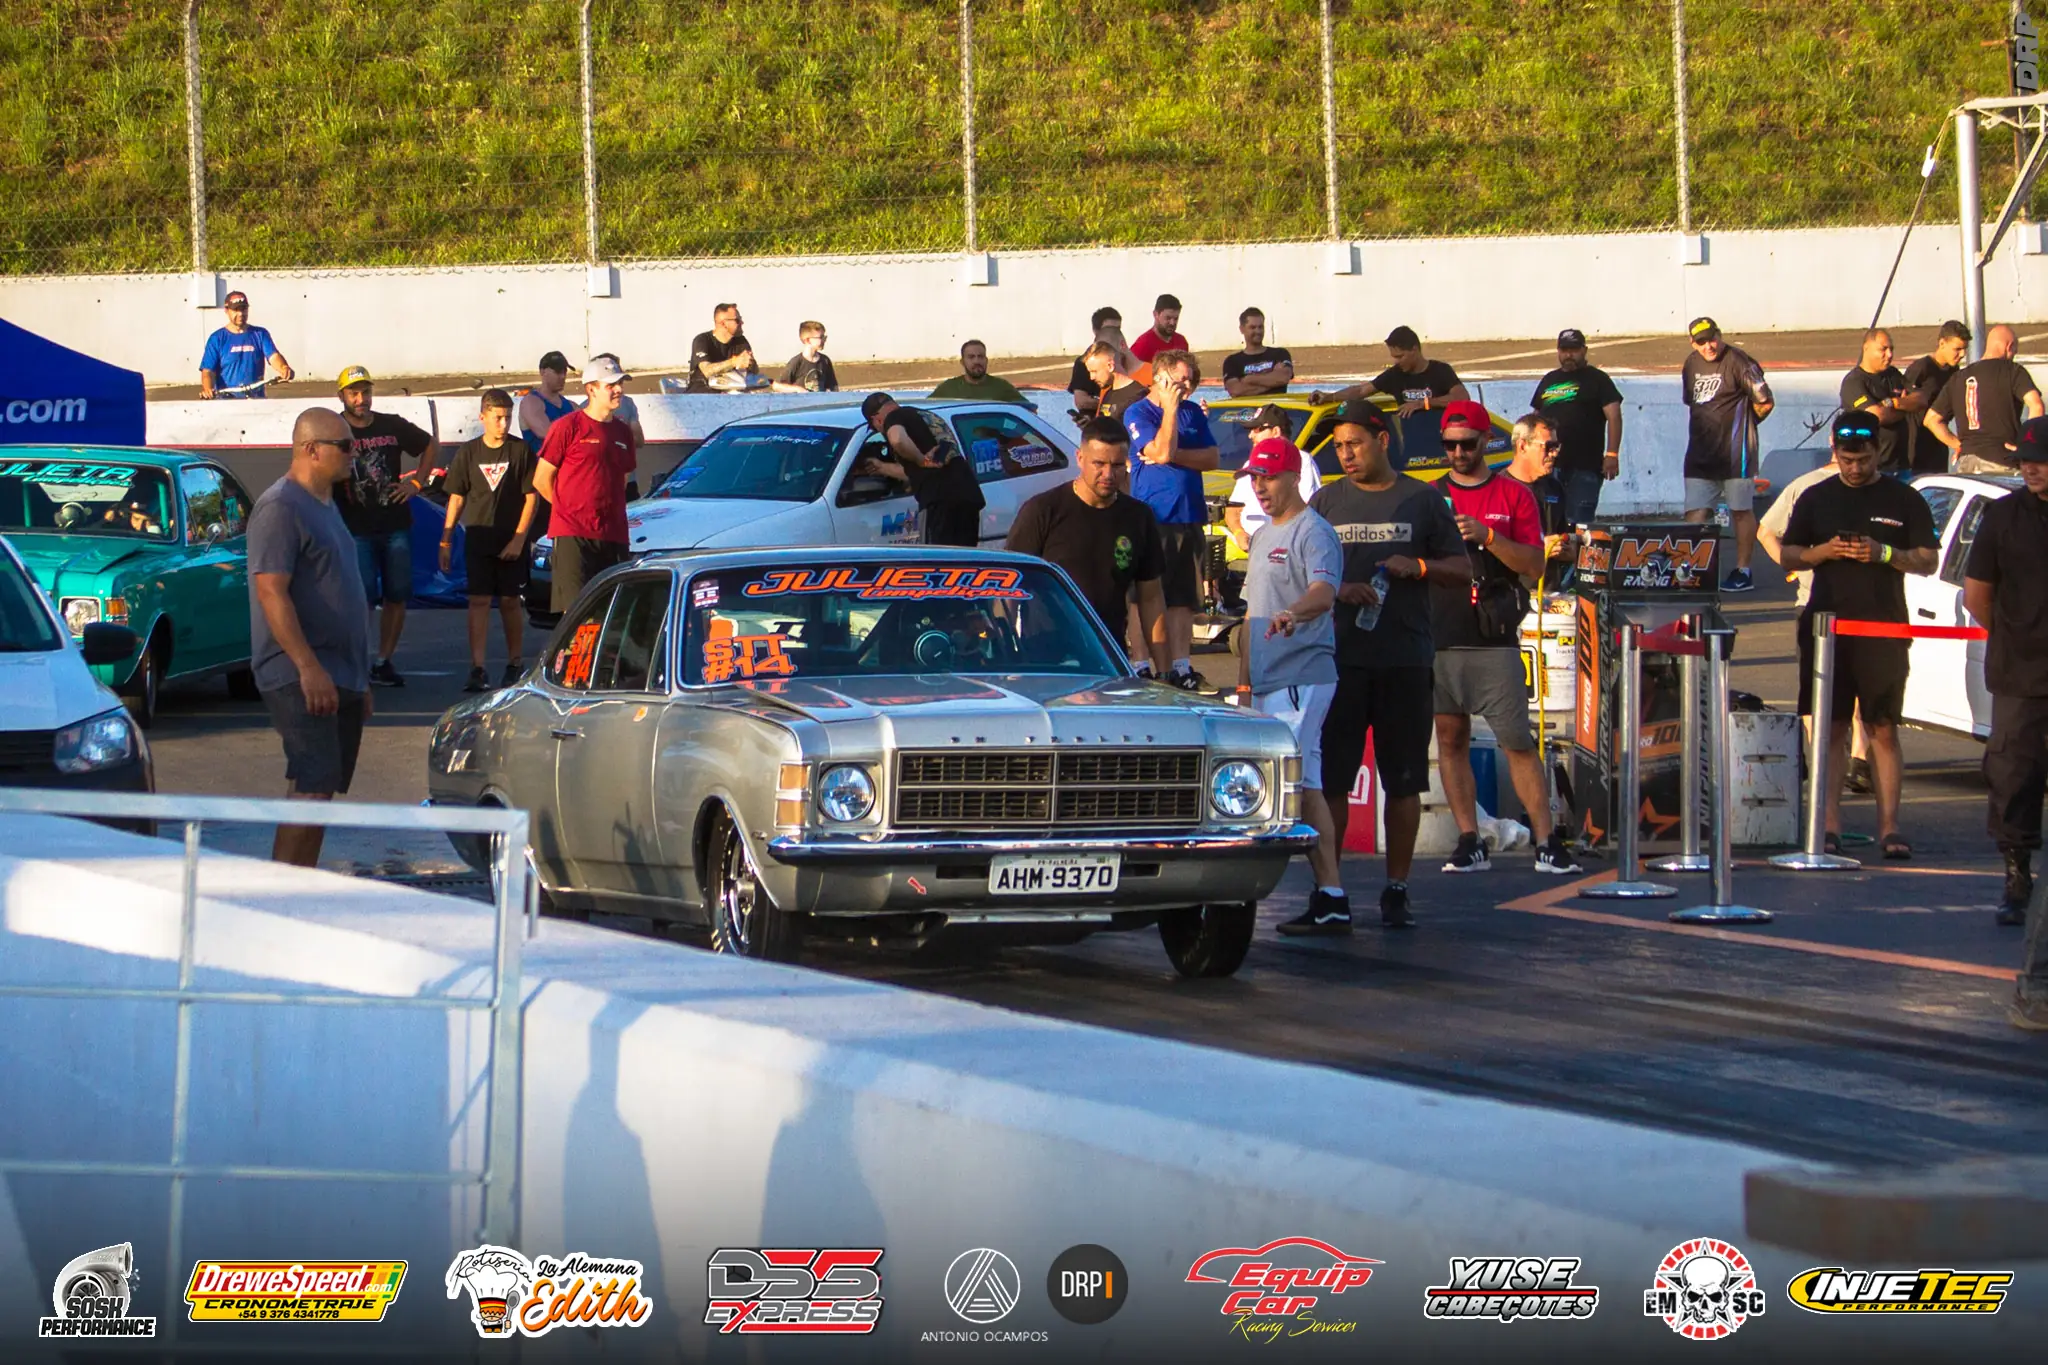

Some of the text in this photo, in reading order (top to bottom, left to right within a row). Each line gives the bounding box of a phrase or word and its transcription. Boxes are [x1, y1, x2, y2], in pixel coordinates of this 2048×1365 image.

[2014, 12, 2040, 91] DRP
[745, 567, 1023, 597] JULIETA
[703, 634, 789, 663] STT
[703, 655, 797, 685] #14
